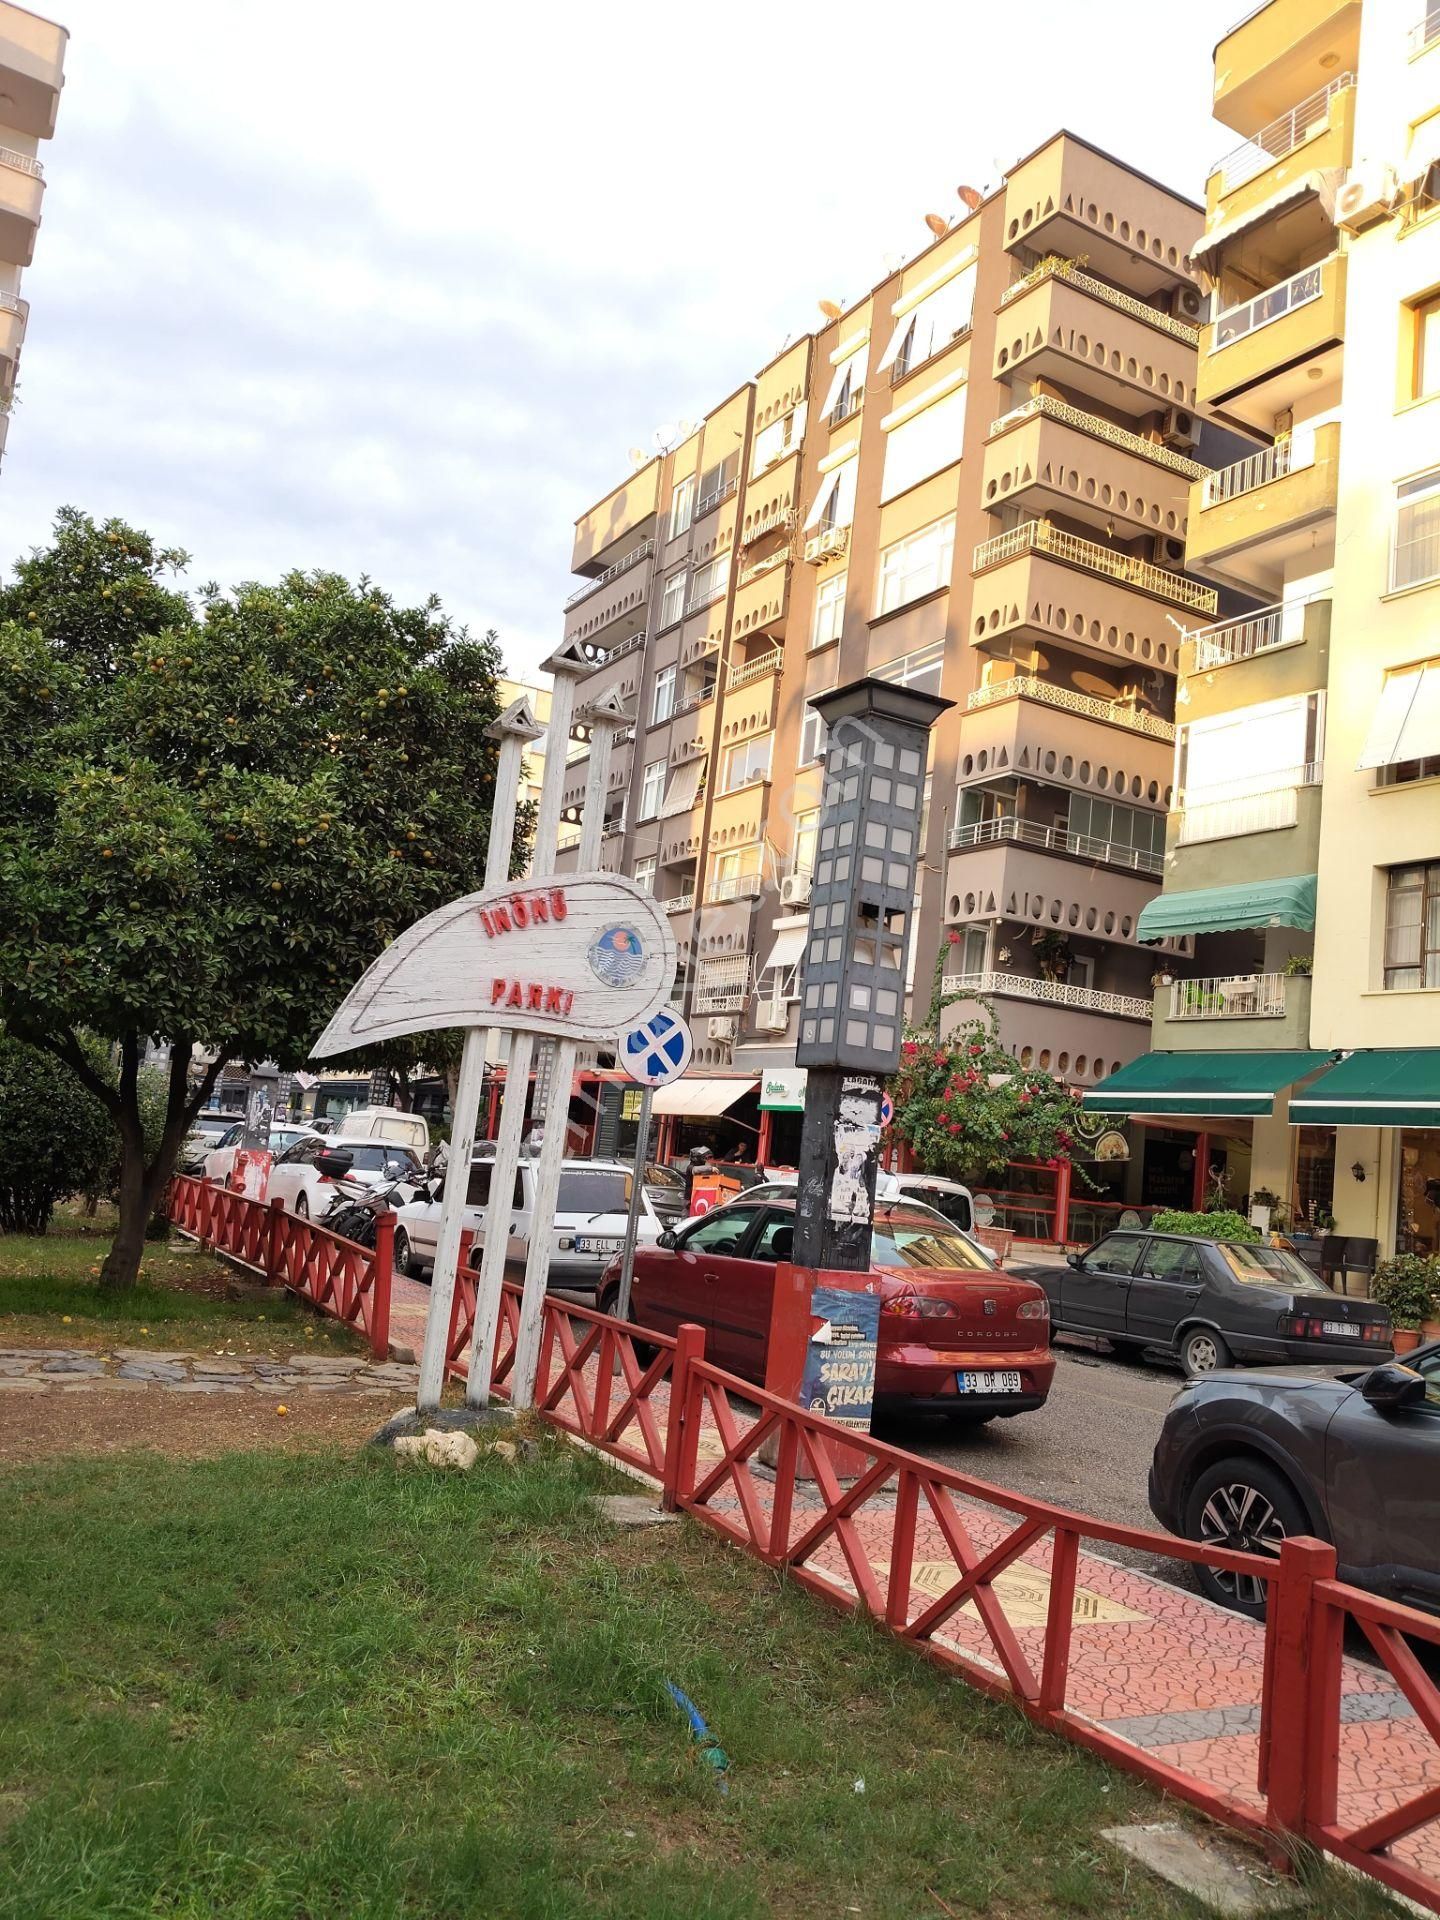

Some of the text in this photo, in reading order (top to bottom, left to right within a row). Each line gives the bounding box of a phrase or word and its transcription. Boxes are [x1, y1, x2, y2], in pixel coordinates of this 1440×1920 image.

[581, 1239, 591, 1249] 33
[596, 1240, 610, 1250] ELL
[965, 1373, 978, 1387] 33
[1002, 1372, 1019, 1387] 089
